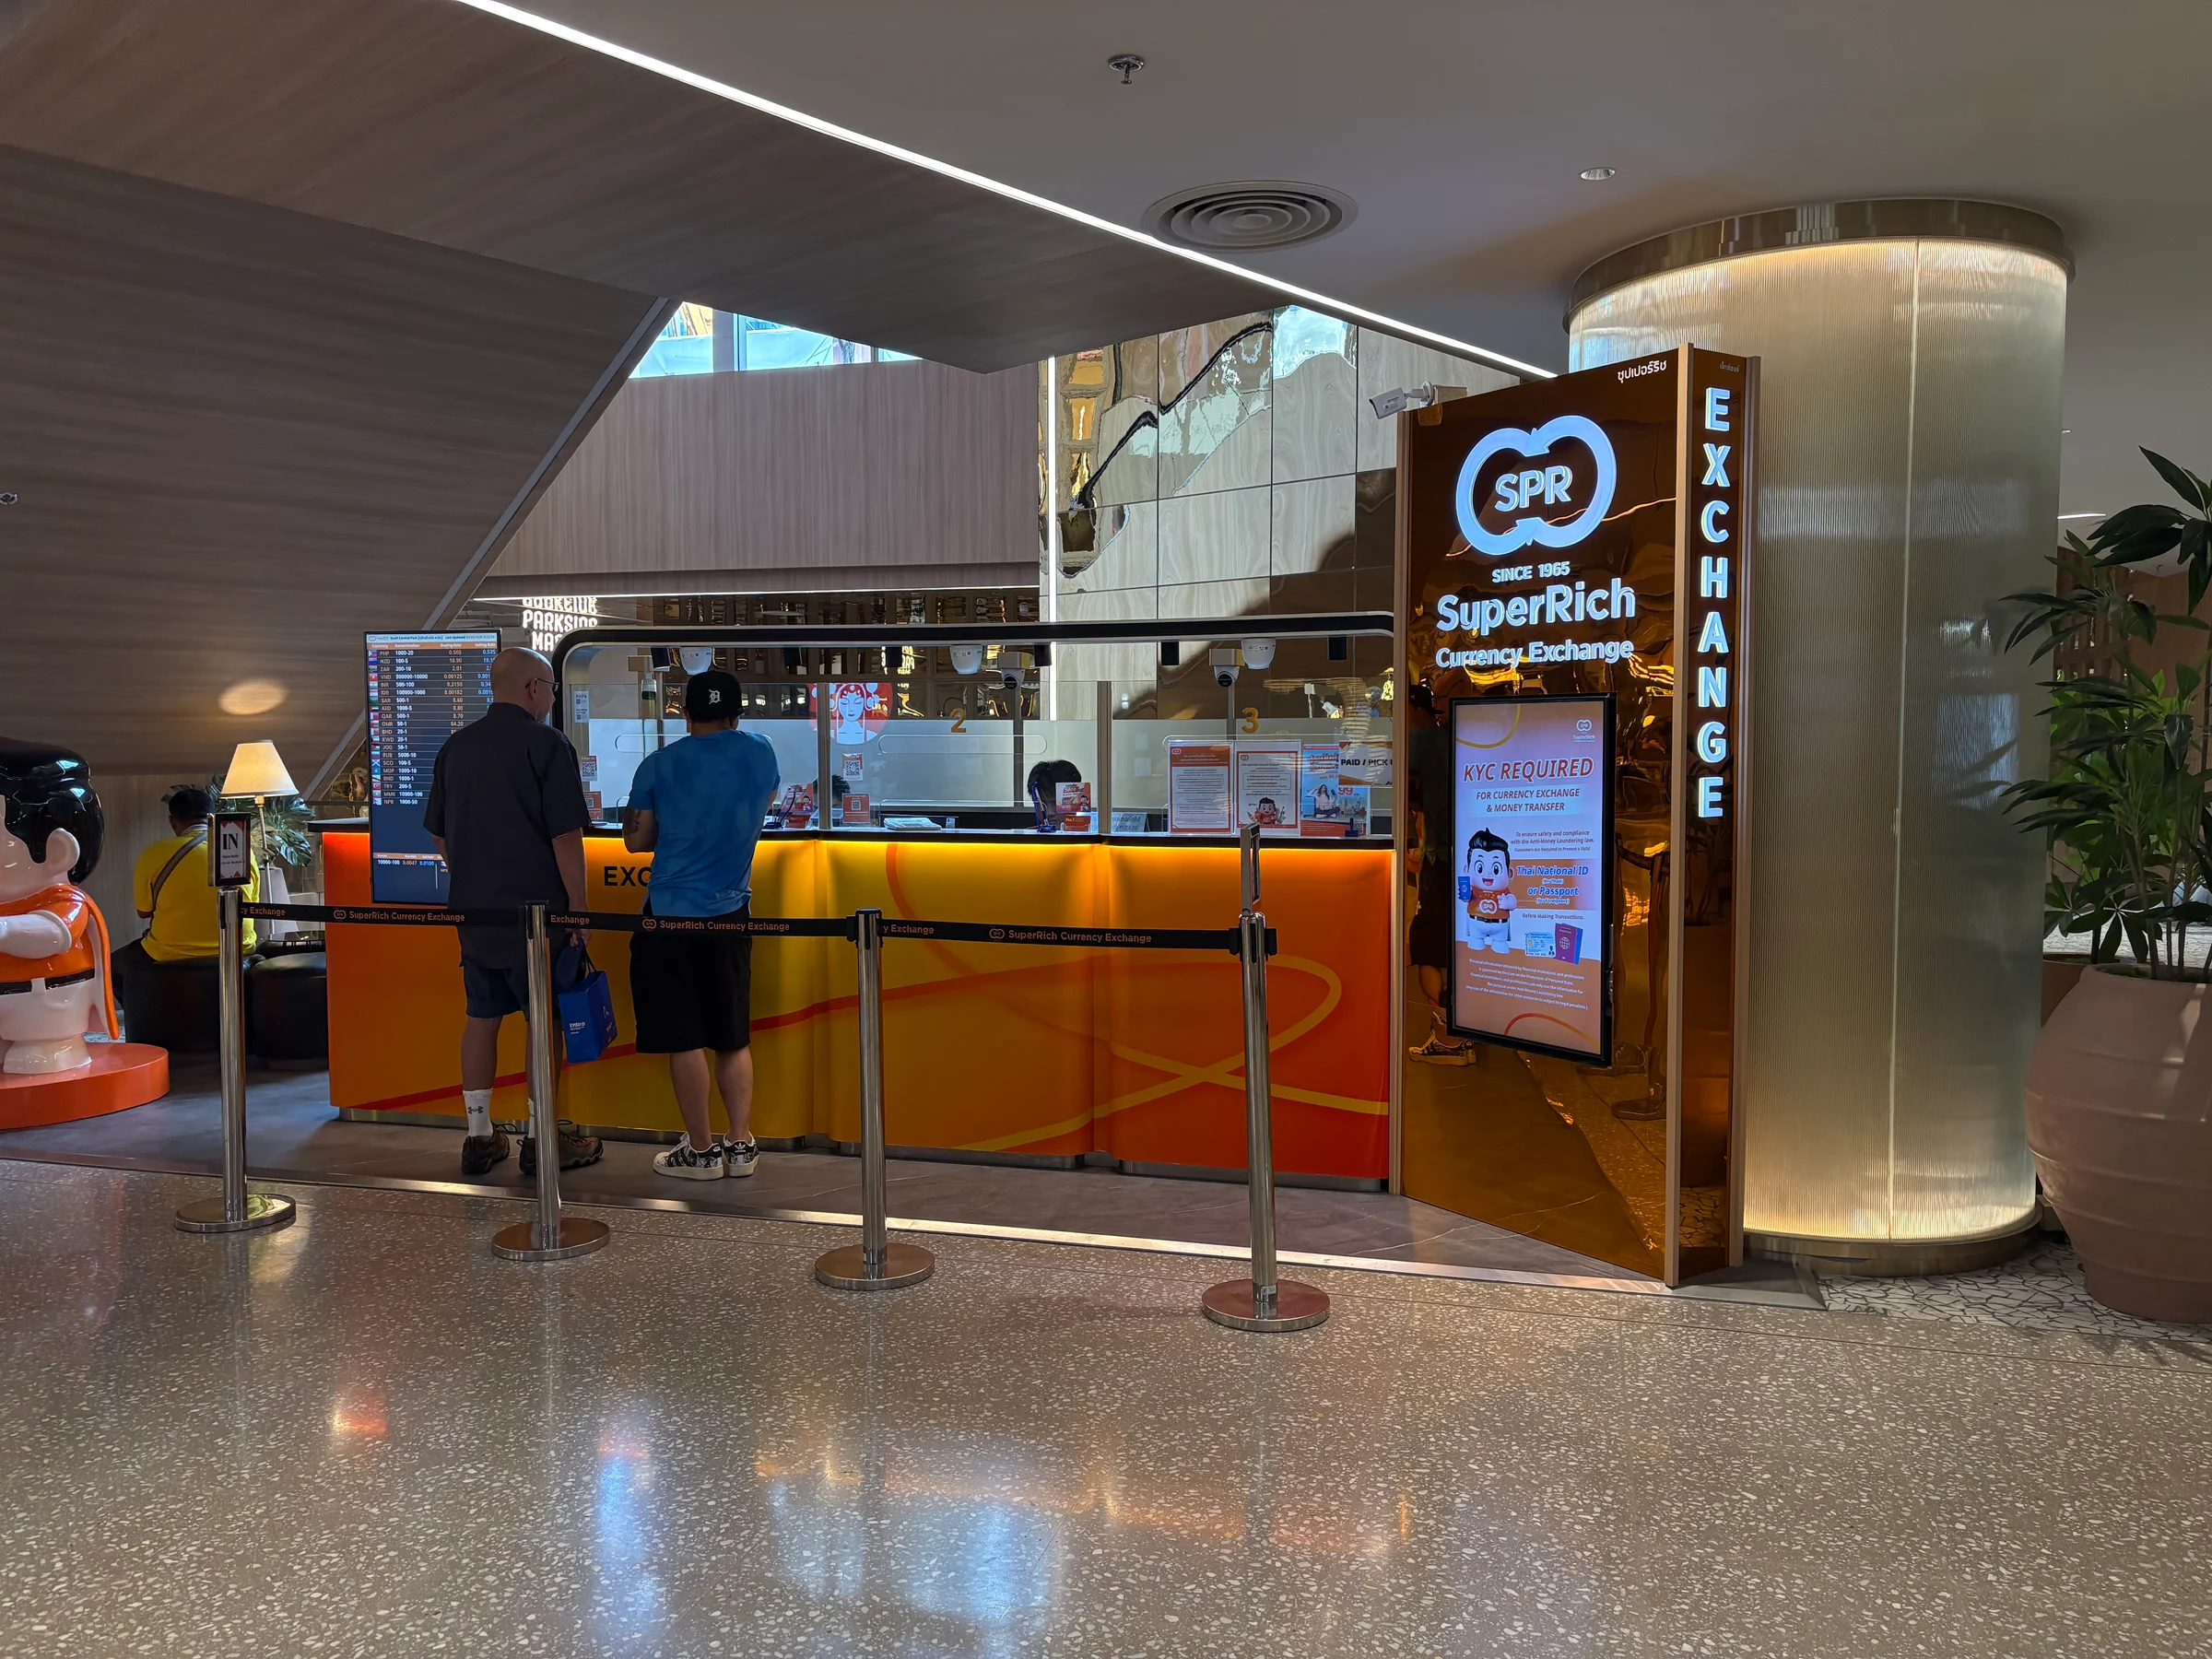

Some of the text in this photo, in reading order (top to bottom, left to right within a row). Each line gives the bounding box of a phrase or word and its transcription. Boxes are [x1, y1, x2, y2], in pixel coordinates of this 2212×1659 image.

[1494, 465, 1573, 512] SPR
[1492, 560, 1571, 583] SINCE 1965
[1436, 578, 1636, 636] SuperRich
[1698, 386, 1732, 819] EXCHANGE
[1435, 639, 1634, 668] Currency Exchange
[950, 708, 967, 733] 2
[1241, 707, 1260, 734] 3
[1463, 757, 1594, 782] KYC REQUIRED
[1477, 788, 1581, 800] FOR CURRENCY EXCHANGE
[1486, 802, 1565, 812] & MONEY TRANSFER
[222, 832, 239, 850] IN
[1516, 865, 1589, 876] Thai National ID
[1527, 886, 1579, 898] or Passport
[250, 906, 286, 917] Exchange
[348, 911, 389, 920] SuperRich
[391, 912, 426, 922] Currency
[427, 912, 465, 923] Exchange
[550, 914, 590, 924] Exchange
[659, 920, 705, 930] SuperRich
[707, 921, 746, 932] Currency
[747, 922, 790, 932] Exchange
[890, 924, 935, 935] Exchange
[1008, 929, 1057, 940] SuperRich
[1060, 931, 1103, 943] Currency
[1105, 933, 1152, 944] Exchange
